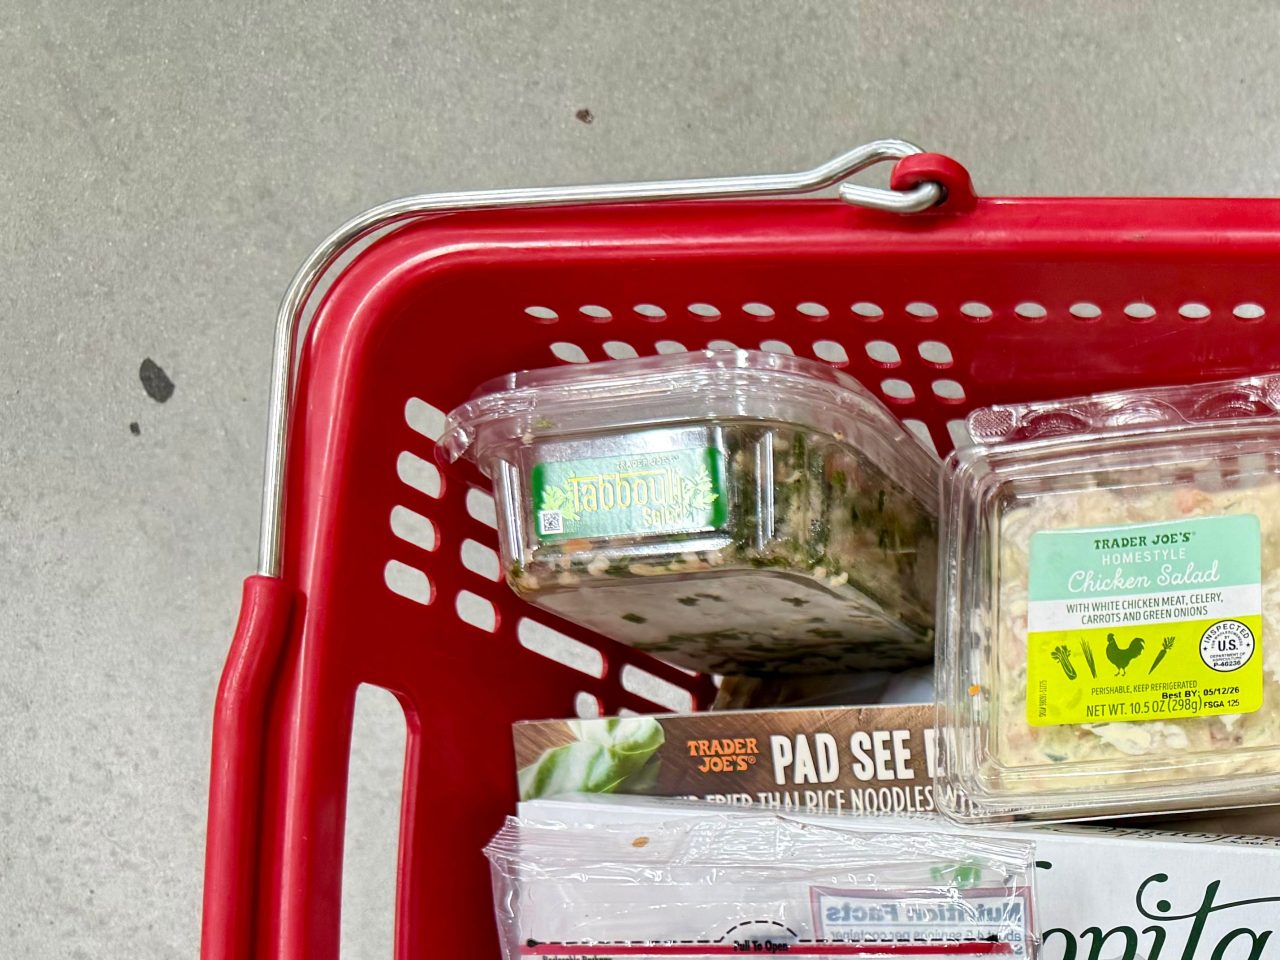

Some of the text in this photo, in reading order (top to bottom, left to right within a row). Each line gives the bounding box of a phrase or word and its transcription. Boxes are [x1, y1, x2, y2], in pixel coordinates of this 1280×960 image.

[1094, 532, 1192, 550] TRADER JOE'S
[1102, 548, 1186, 566] HOMESTYLE
[1068, 560, 1220, 593] Chicken Salad
[1066, 592, 1223, 614] WITH WHITE CHICKEN MEAT, CELERY,
[1082, 605, 1208, 625] CARROTS AND GREEN ONIONS
[1203, 623, 1250, 644] INSPECTED
[1217, 639, 1239, 652] U.S.
[1091, 680, 1198, 696] PERISHABLE, KEEP REFRIGERATED
[1161, 686, 1240, 700] Best BY: 05/12/26
[1086, 696, 1203, 718] NET WT. 10.5 OZ (298g)
[1203, 698, 1240, 709] FSGA 125
[687, 737, 760, 757] TRADER
[698, 754, 750, 773] JOE'S
[769, 729, 915, 785] PAD SEE
[756, 791, 800, 811] THAI
[804, 789, 847, 815] RICE
[851, 786, 934, 813] NOODLES
[752, 940, 763, 952] To
[765, 941, 790, 954] Open
